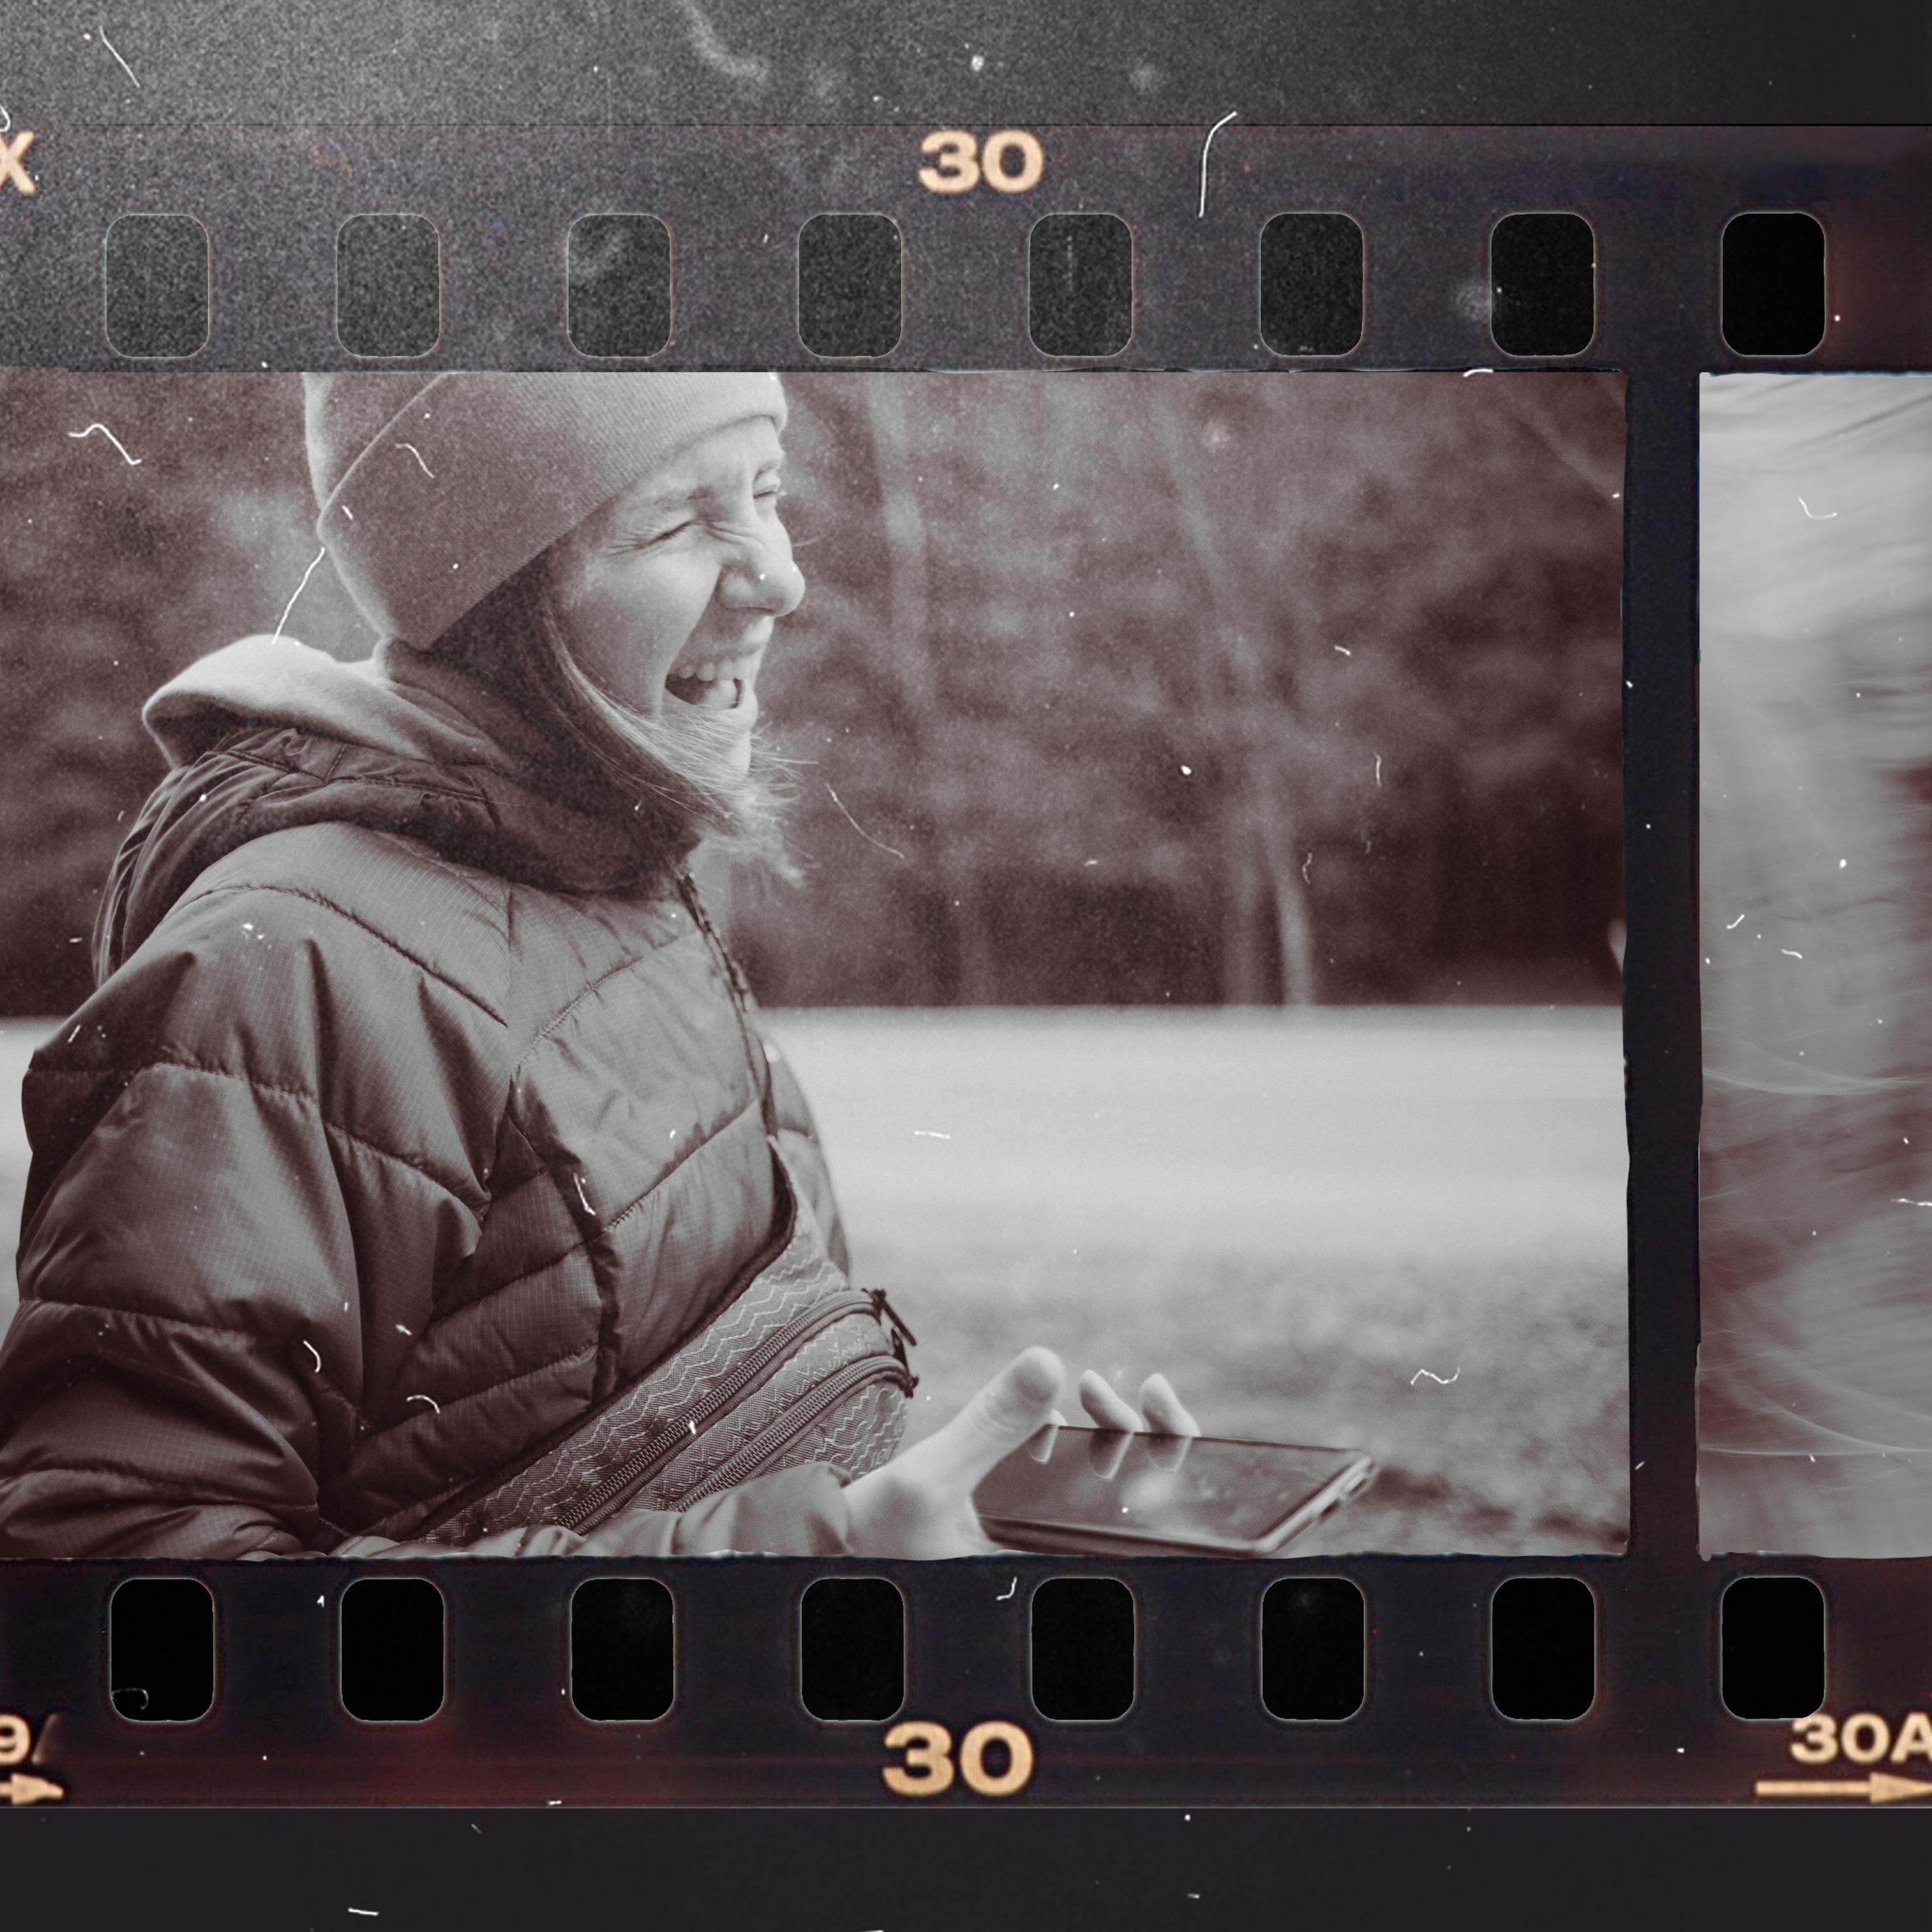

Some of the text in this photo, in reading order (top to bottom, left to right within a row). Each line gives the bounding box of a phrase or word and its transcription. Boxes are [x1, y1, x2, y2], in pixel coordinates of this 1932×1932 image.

[0, 130, 36, 194] X
[918, 129, 1043, 193] 30
[883, 1721, 1033, 1795] 30
[1790, 1712, 1932, 1763] 30A
